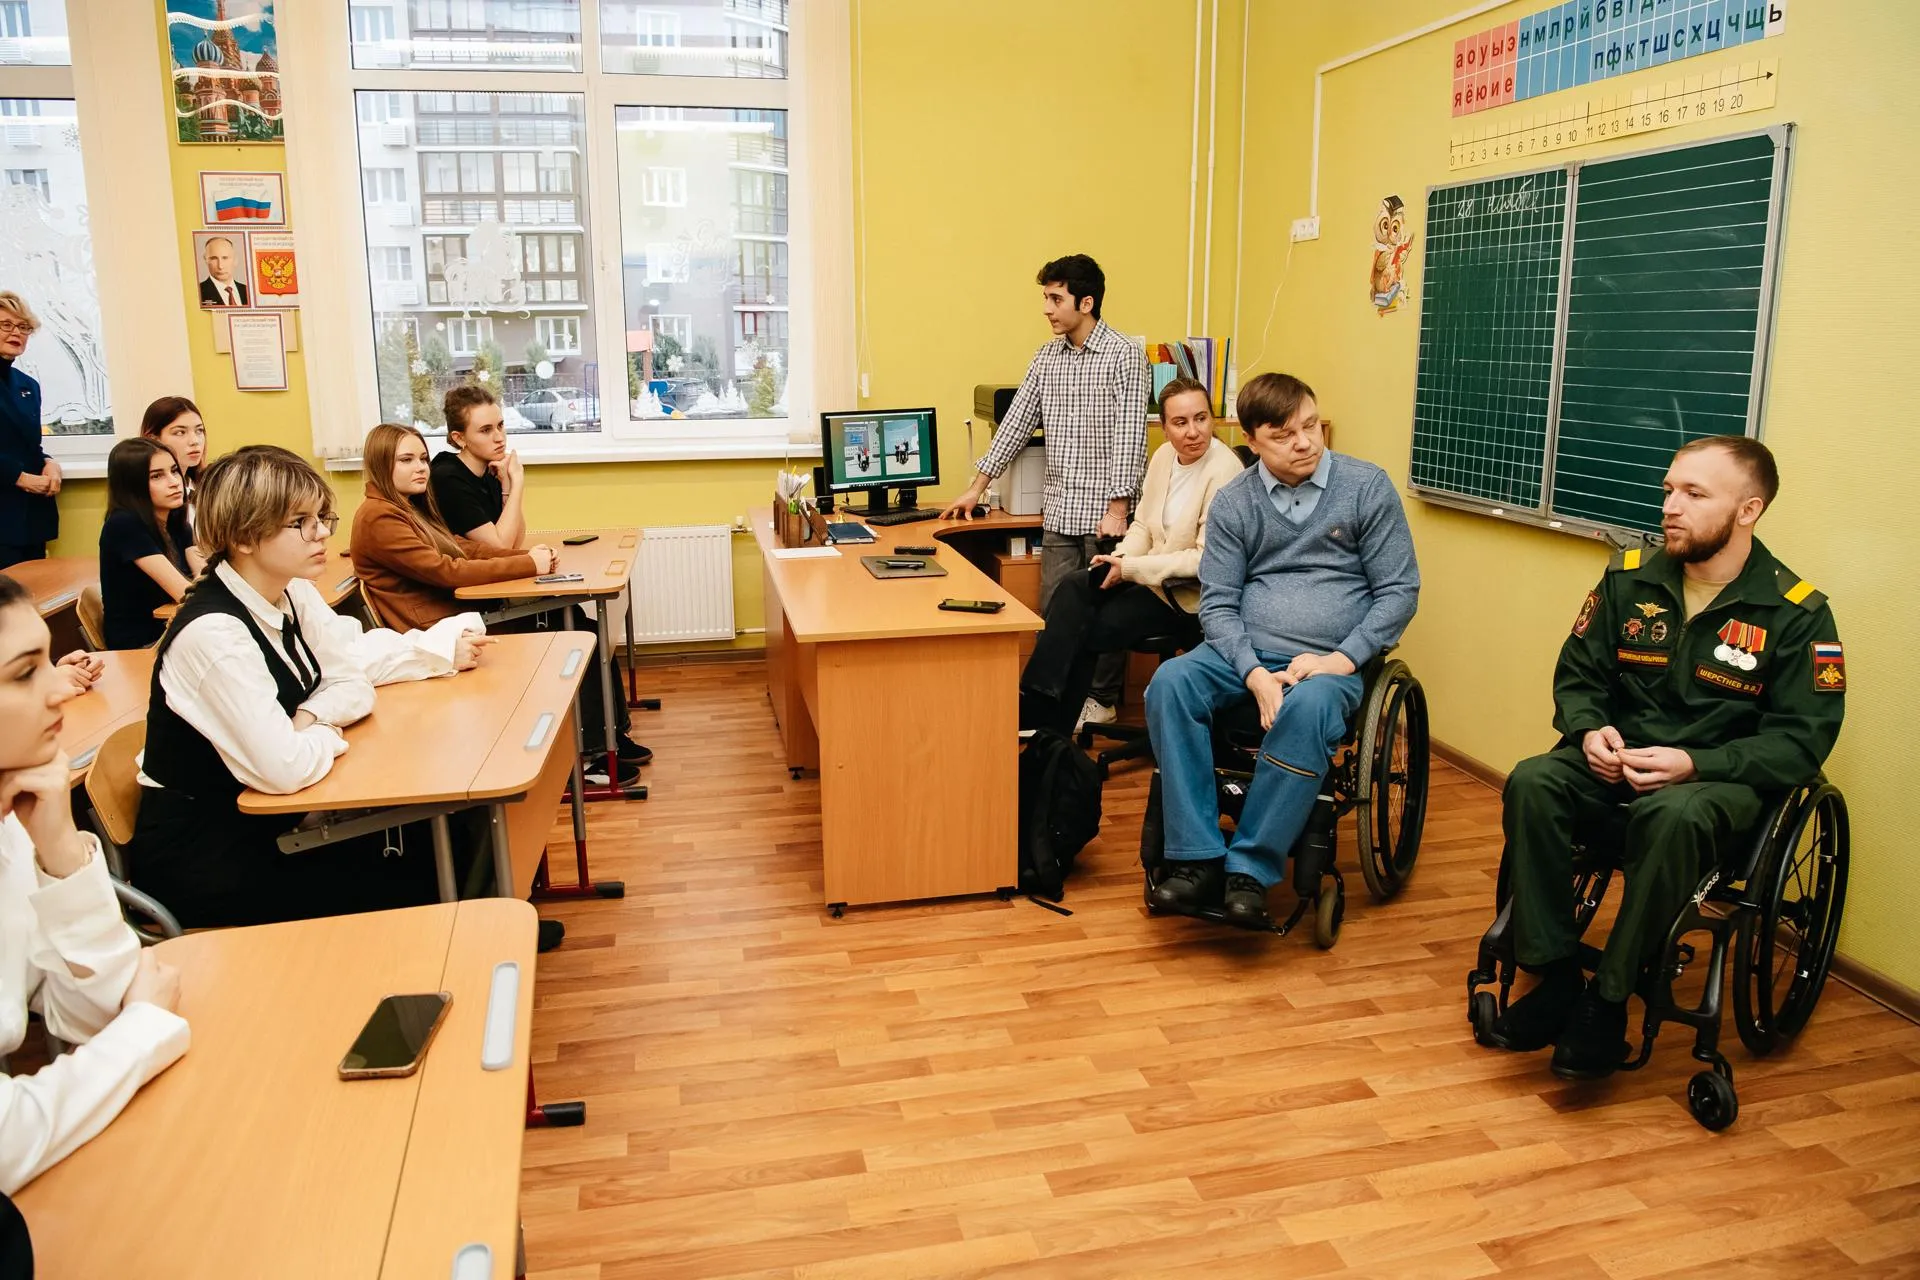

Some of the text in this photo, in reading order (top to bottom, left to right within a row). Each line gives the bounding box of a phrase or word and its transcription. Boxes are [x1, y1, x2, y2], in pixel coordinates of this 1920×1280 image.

[1454, 4, 1783, 108] я ё ю и е п ф к т ш с х ц ч щ ь
[1455, 54, 1464, 69] а
[1467, 50, 1476, 65] о
[1479, 45, 1488, 67] у
[1491, 40, 1504, 57] ы
[1507, 36, 1516, 52] э
[1520, 31, 1530, 48] н
[1534, 26, 1546, 44] м
[1549, 21, 1560, 40] л
[1564, 17, 1575, 41] р
[1579, 6, 1590, 30] й
[1596, 0, 1607, 23] б
[1568, 130, 1578, 142] 10
[1586, 127, 1594, 139] 11
[1598, 123, 1607, 136] 12
[1611, 120, 1620, 133] 13
[1625, 117, 1634, 129] 14
[1641, 113, 1652, 127] 15
[1658, 110, 1670, 123] 16
[1677, 106, 1688, 120] 17
[1695, 103, 1706, 117] 18
[1713, 99, 1725, 113] 19
[1730, 94, 1744, 110] 20
